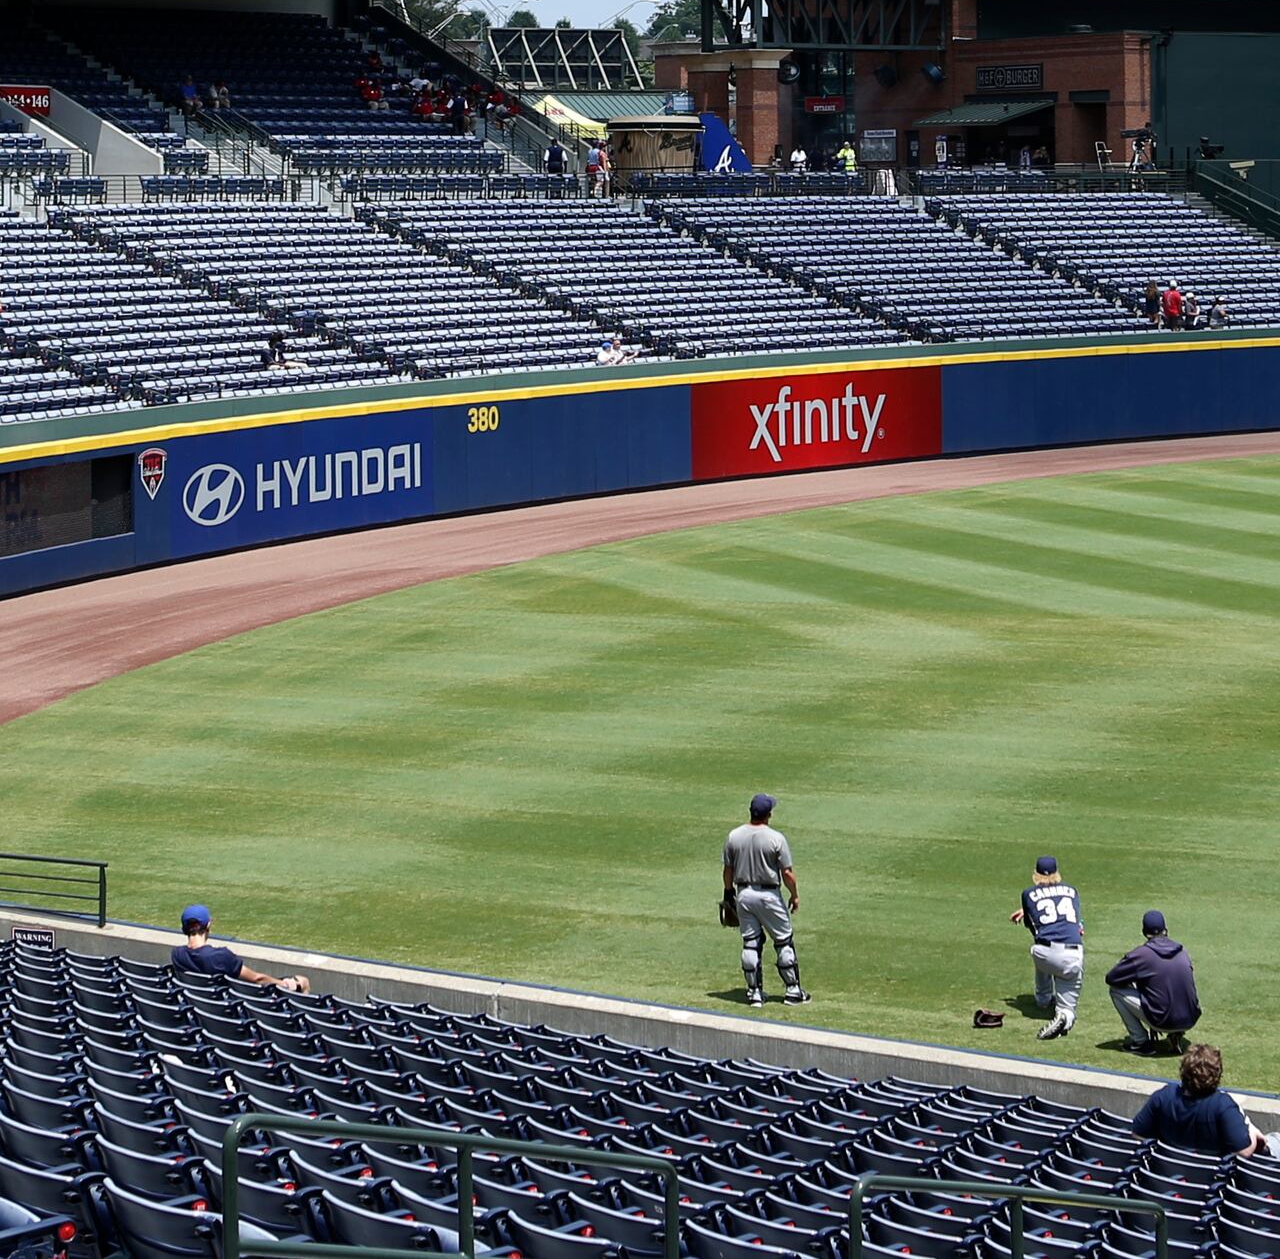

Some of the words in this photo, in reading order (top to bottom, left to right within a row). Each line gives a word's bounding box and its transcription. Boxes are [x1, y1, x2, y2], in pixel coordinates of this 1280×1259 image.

[1007, 70, 1038, 83] BURGER
[31, 95, 49, 107] 146
[467, 406, 500, 434] 380
[749, 382, 886, 462] xfinity
[256, 442, 421, 512] HYUNDAI
[1036, 896, 1077, 925] 34
[15, 932, 52, 942] WARNING
